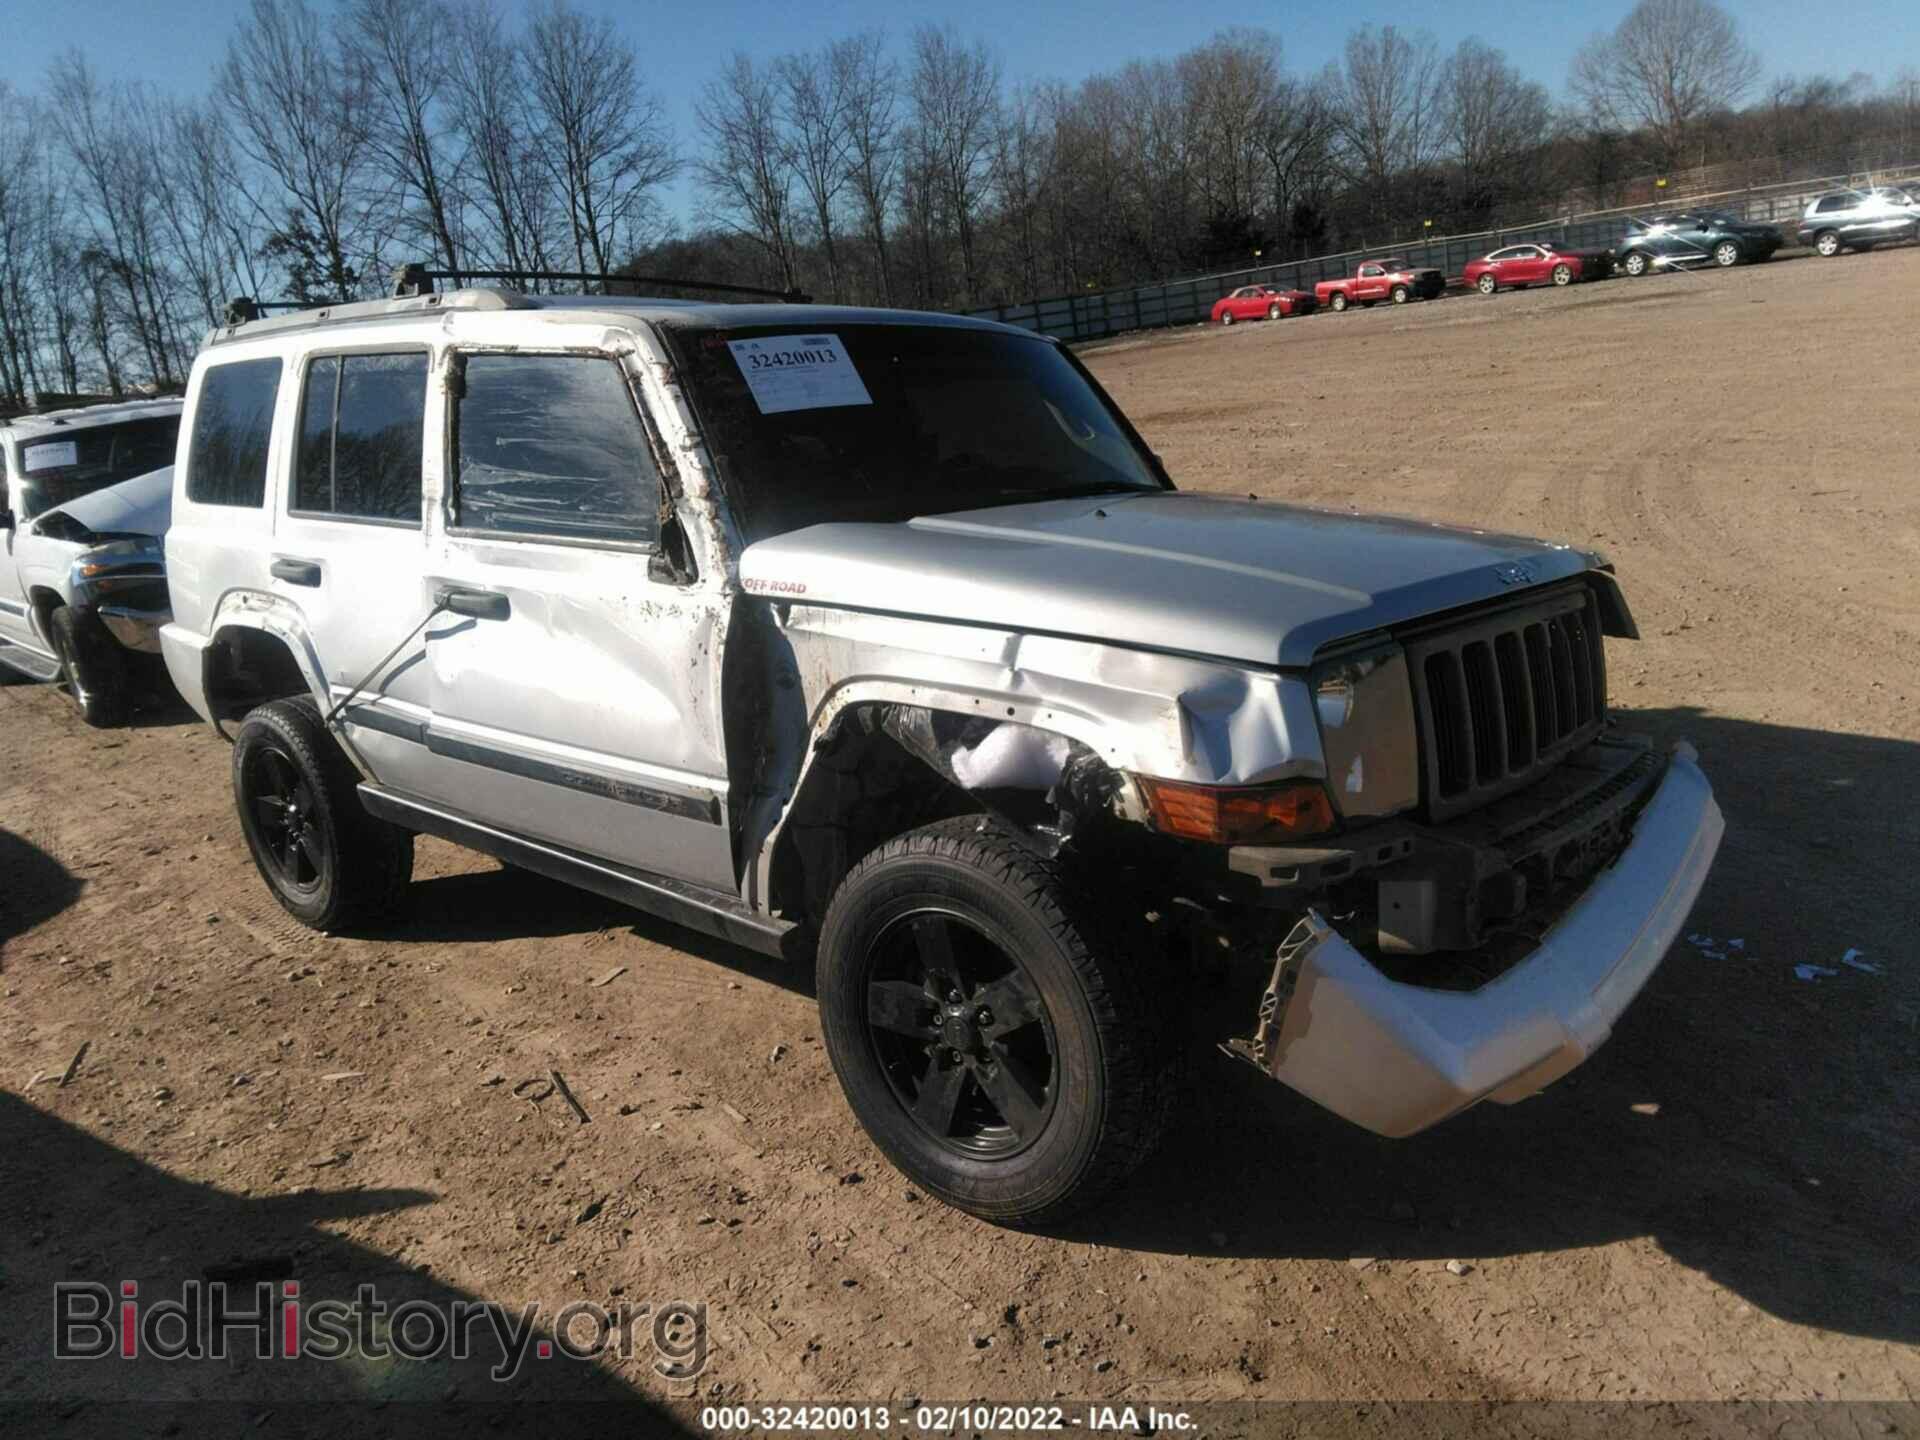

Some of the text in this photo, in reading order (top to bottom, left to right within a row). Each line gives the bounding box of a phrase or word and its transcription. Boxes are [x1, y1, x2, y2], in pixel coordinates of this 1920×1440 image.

[748, 349, 837, 369] 32420013
[744, 578, 807, 593] OFF ROAD
